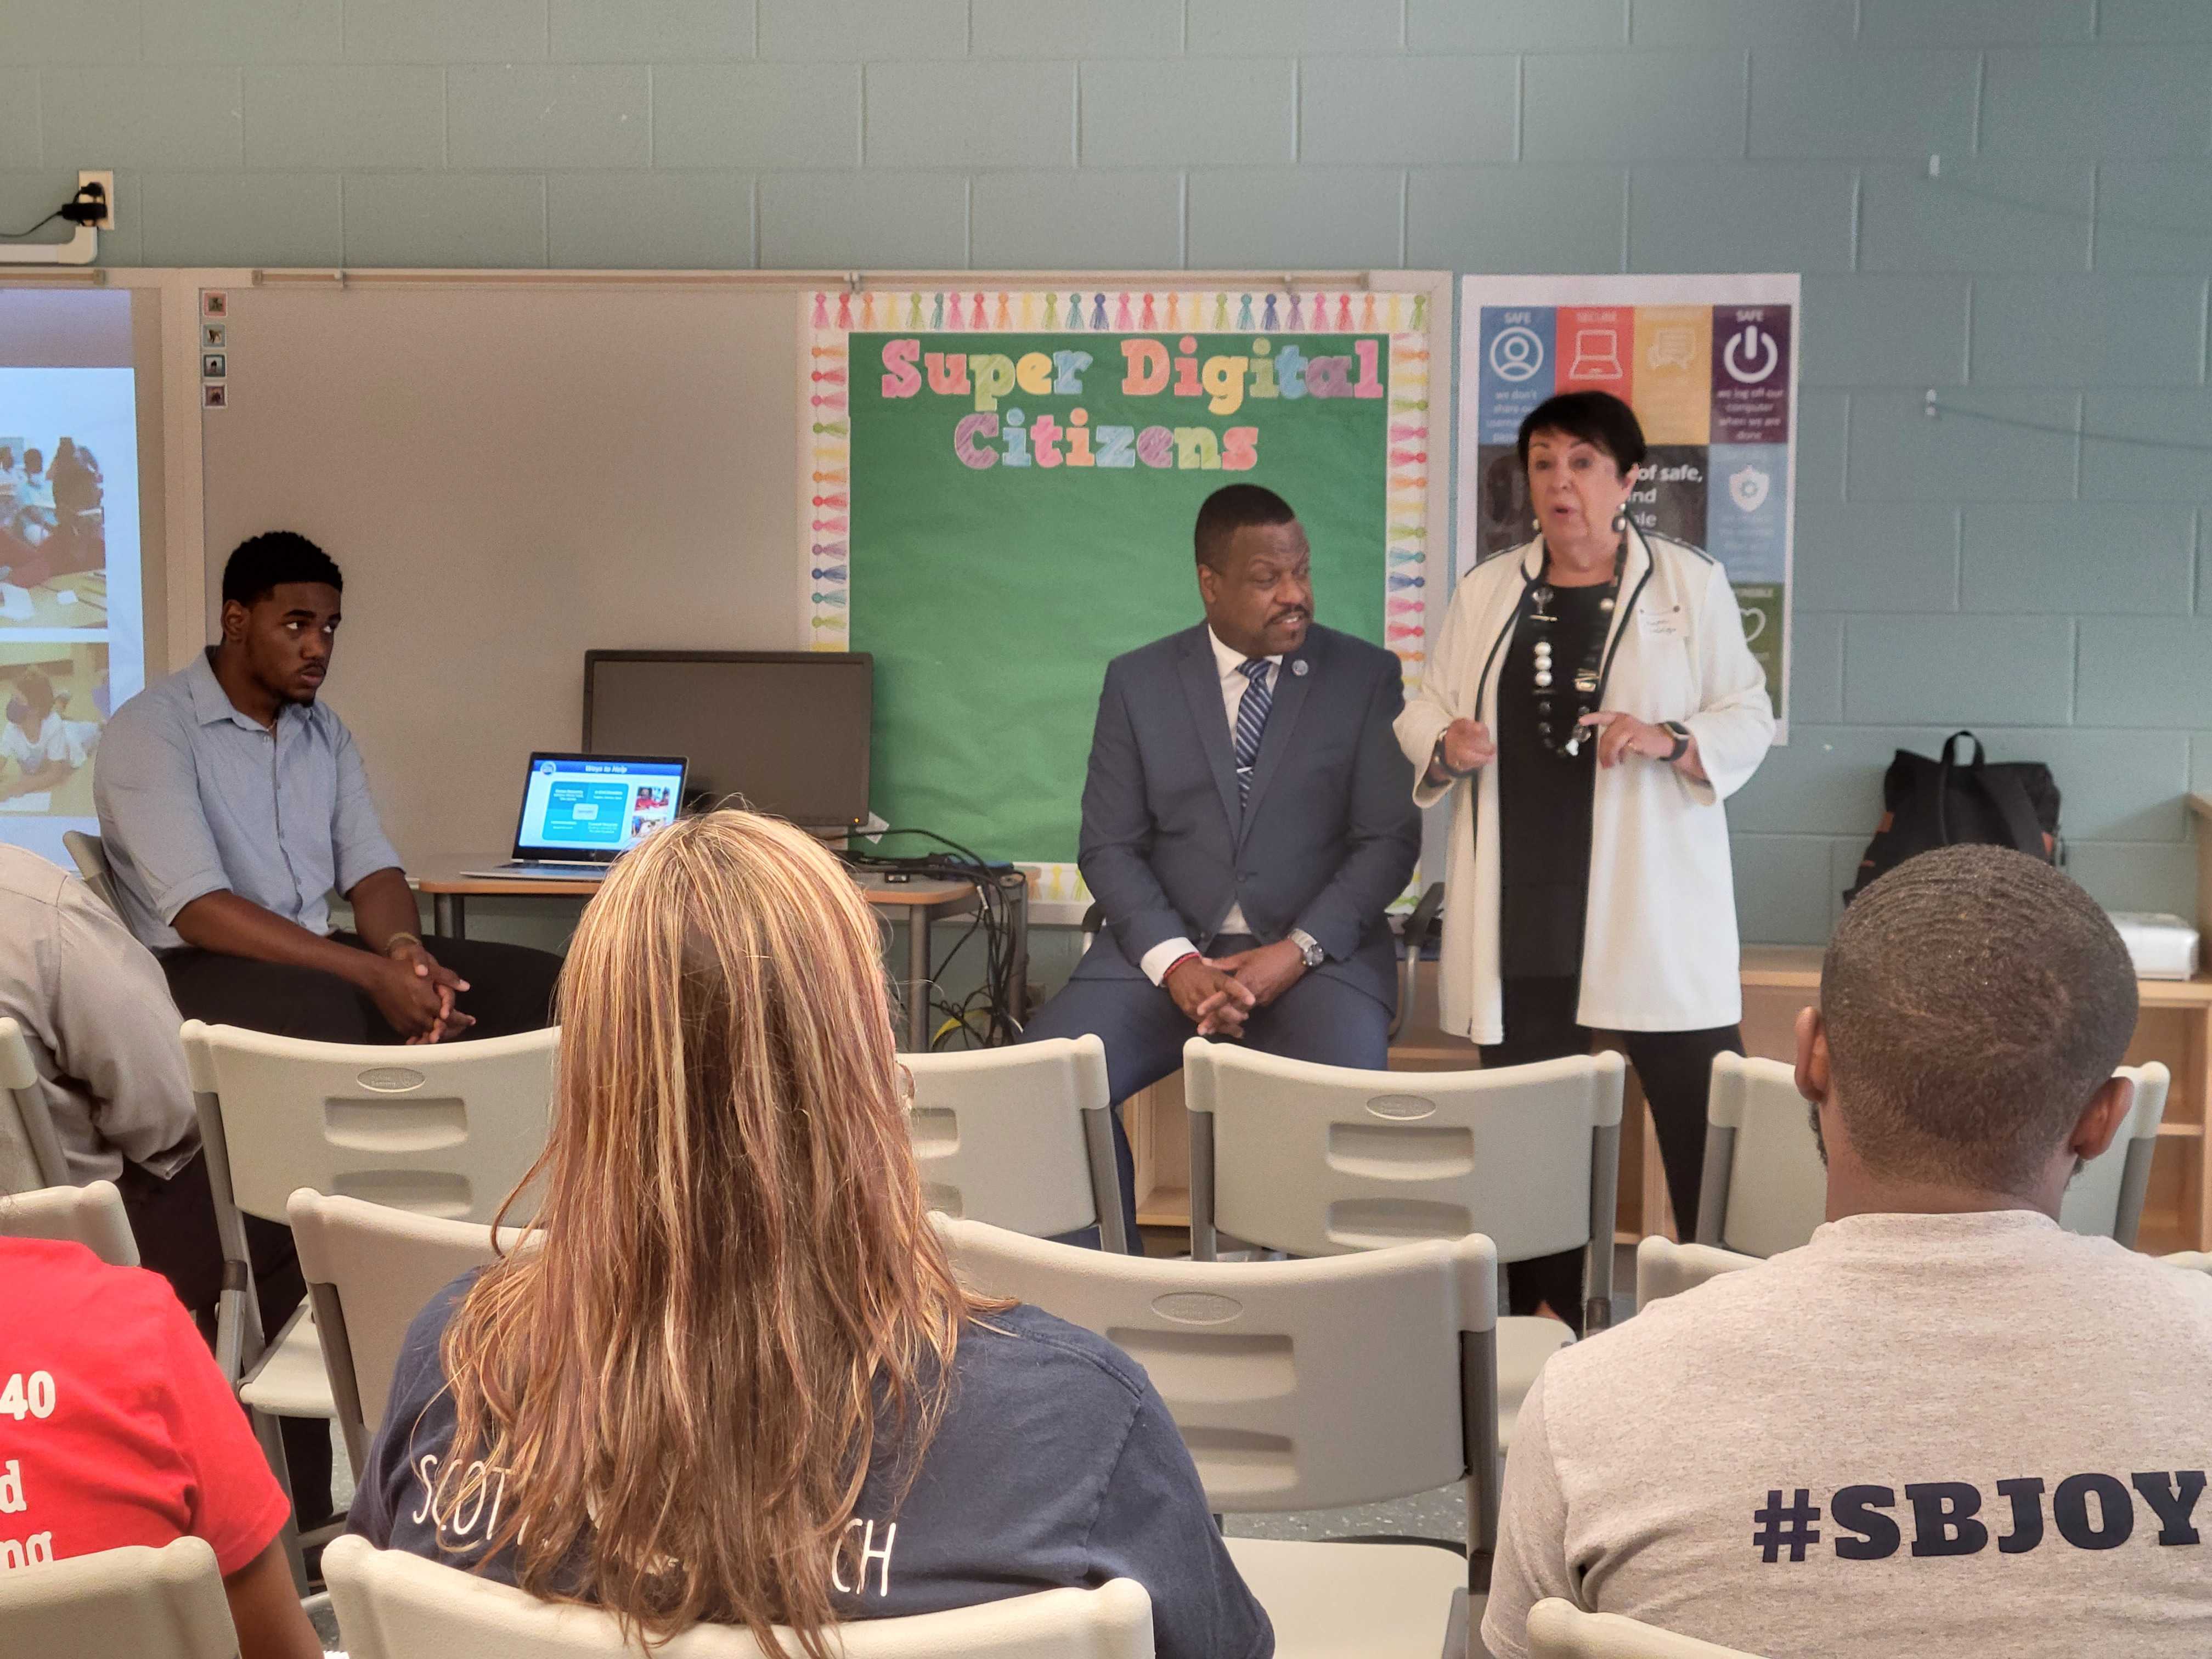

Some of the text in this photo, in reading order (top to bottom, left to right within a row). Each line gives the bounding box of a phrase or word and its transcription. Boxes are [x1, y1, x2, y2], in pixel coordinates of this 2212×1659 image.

[1504, 312, 1531, 324] SAFE
[1735, 309, 1764, 322] SAFE
[881, 335, 1384, 415] Super Digital
[955, 408, 1259, 471] Citizens
[1639, 464, 1703, 483] of safe,
[1628, 488, 1657, 503] nd
[612, 765, 628, 774] Help
[0, 1370, 56, 1420] 40
[1753, 1470, 2207, 1563] #SBJOY
